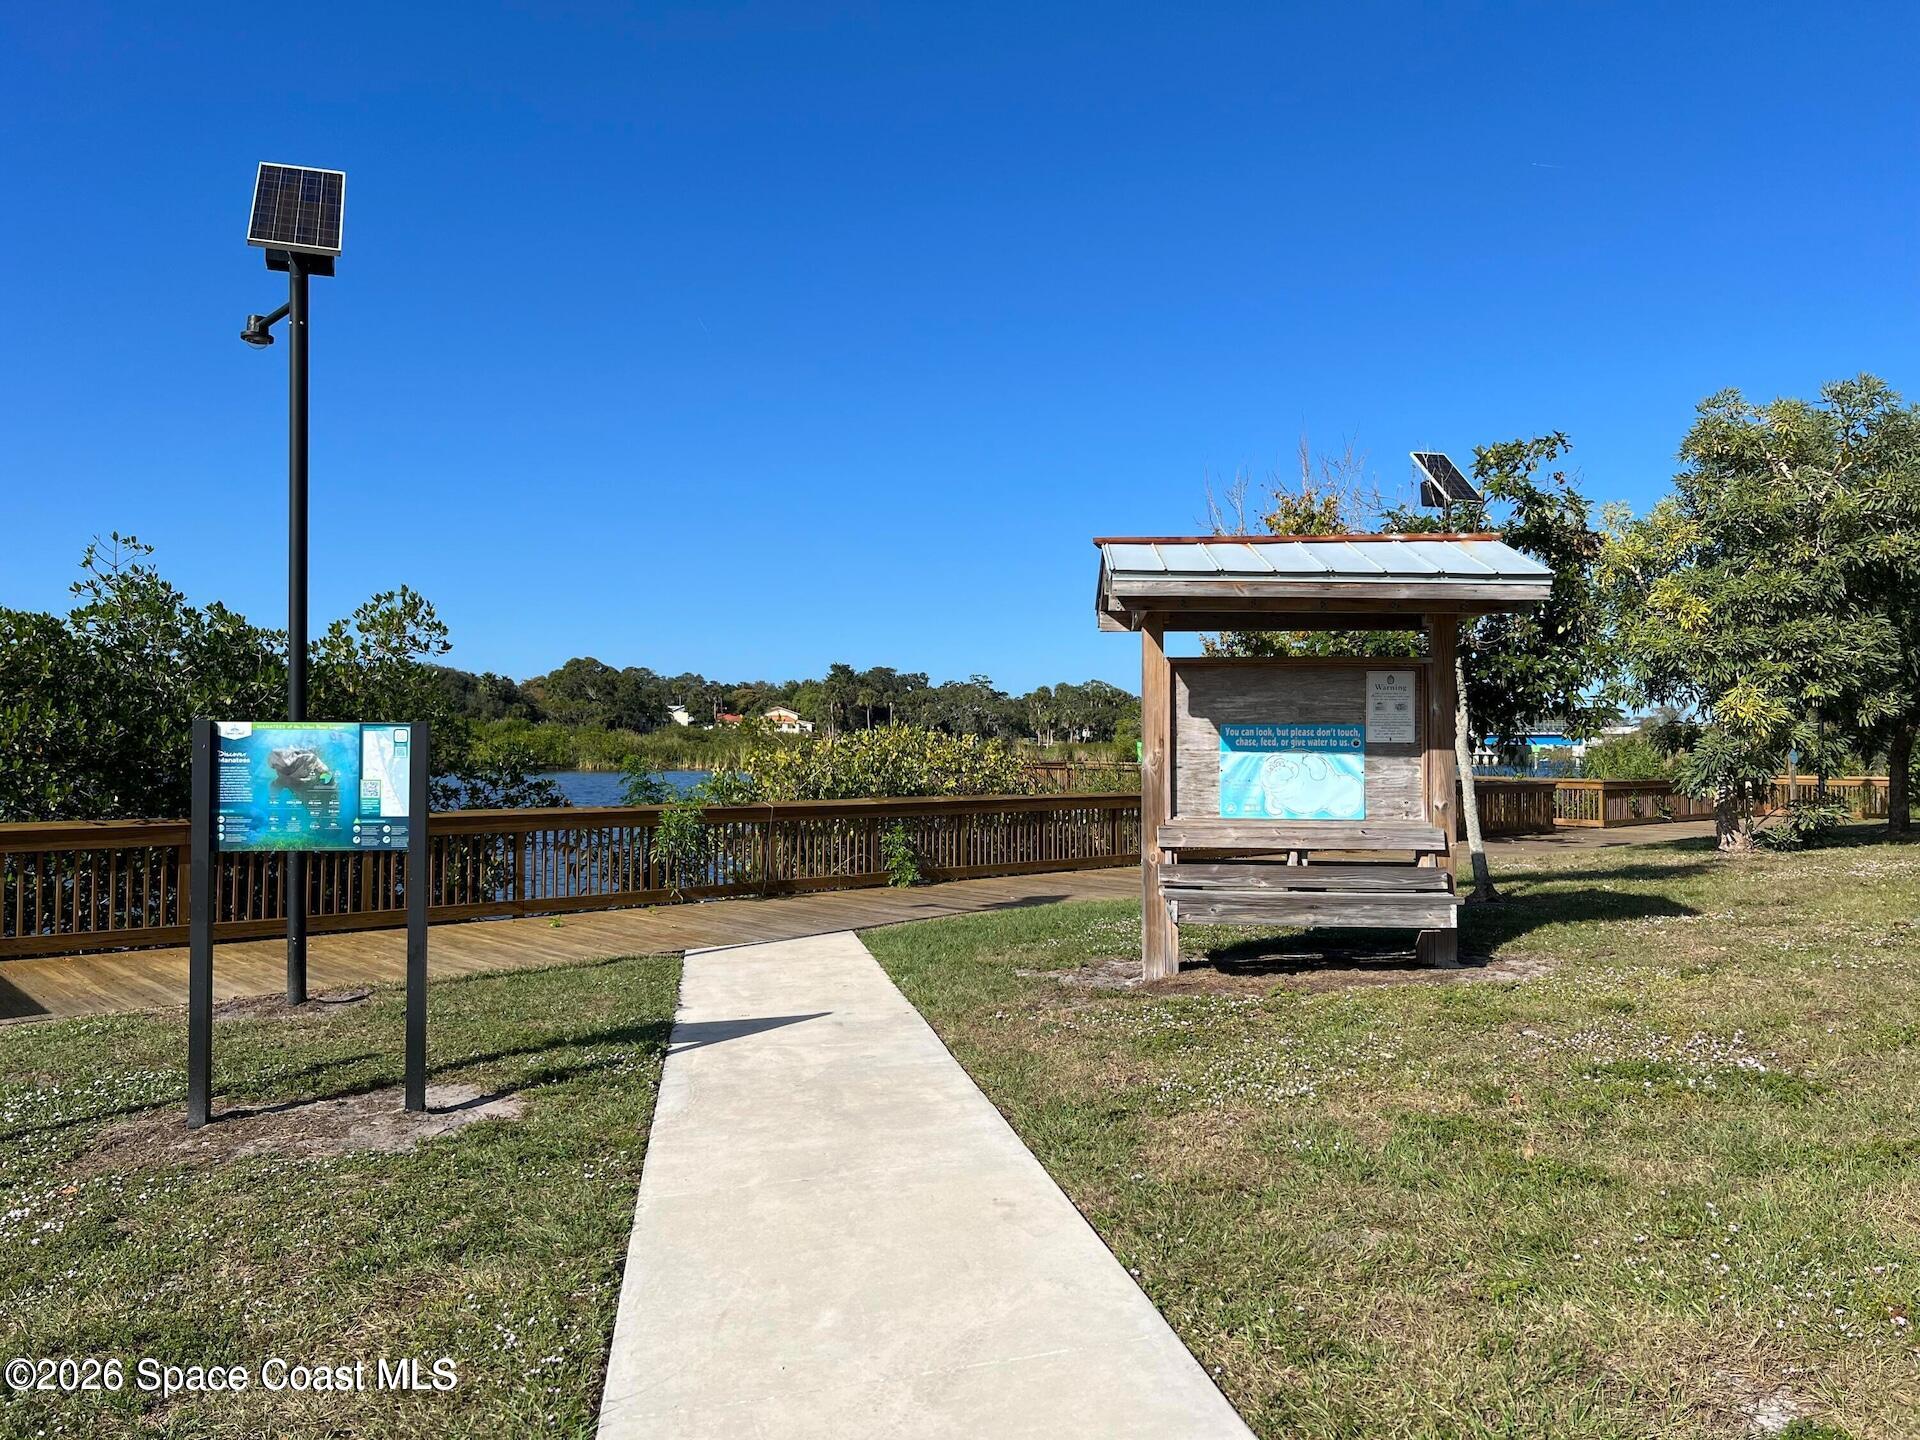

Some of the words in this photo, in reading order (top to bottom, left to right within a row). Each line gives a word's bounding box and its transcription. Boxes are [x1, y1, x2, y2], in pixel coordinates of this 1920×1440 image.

[1375, 683, 1407, 692] Warning
[1225, 727, 1239, 737] You
[1241, 728, 1254, 737] can
[1256, 727, 1275, 739] look,
[1277, 727, 1289, 737] but
[1291, 727, 1315, 740] please
[1316, 727, 1336, 737] don't
[1337, 727, 1361, 738] touch,
[1235, 738, 1259, 748] chase,
[1260, 738, 1279, 748] feed,
[1280, 739, 1289, 747] or
[1291, 738, 1306, 749] give
[1307, 739, 1328, 747] water
[1329, 738, 1338, 747] to
[1339, 739, 1350, 747] us.
